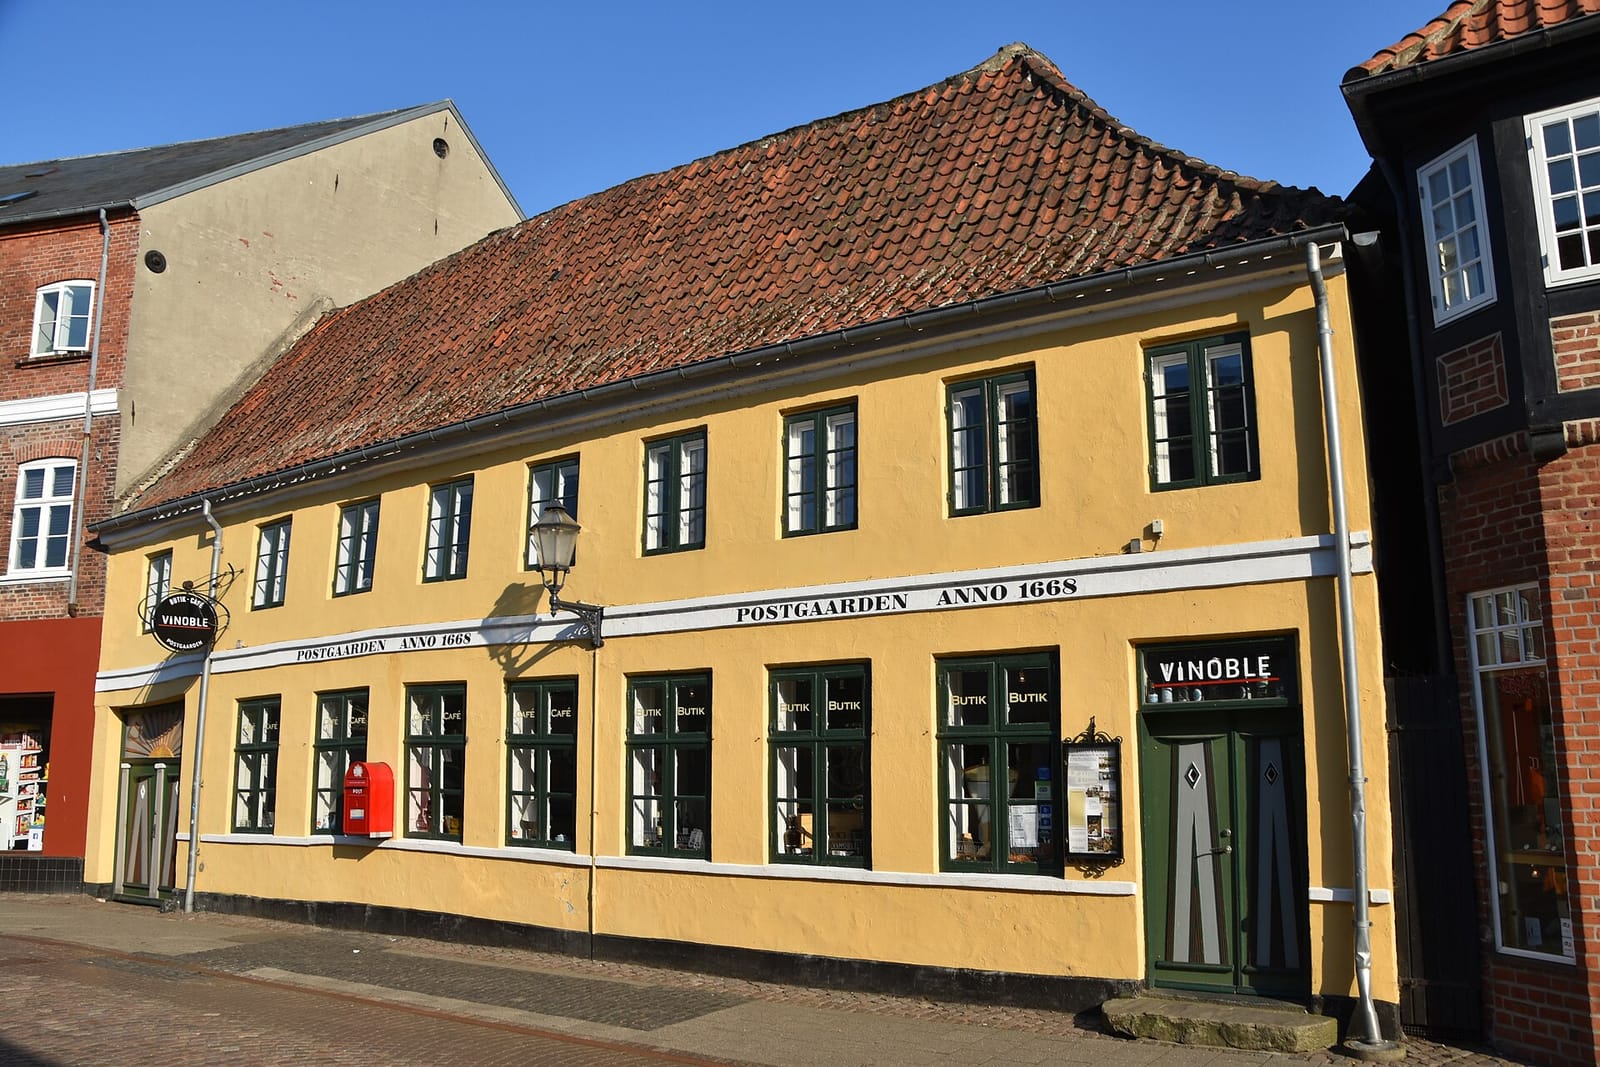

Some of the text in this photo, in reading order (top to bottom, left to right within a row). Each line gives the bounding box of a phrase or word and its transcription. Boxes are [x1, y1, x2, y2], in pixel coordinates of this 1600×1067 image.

[736, 578, 1078, 622] POSTGAARDEN ANNO 1668
[162, 615, 209, 628] VINOBLE
[297, 633, 472, 661] POSTGAARDEN ANNO 1668
[1160, 656, 1271, 682] VINOBLE
[952, 695, 987, 705] BUTIK
[1009, 692, 1048, 703] BUTIK
[677, 706, 705, 716] BUTIK
[780, 703, 810, 713] BUTIK
[829, 701, 861, 711] BUTIK
[444, 710, 462, 720] CAFÉ
[551, 707, 572, 718] CAFÉ
[637, 708, 662, 717] BUTIK
[351, 714, 366, 724] CAFÉ
